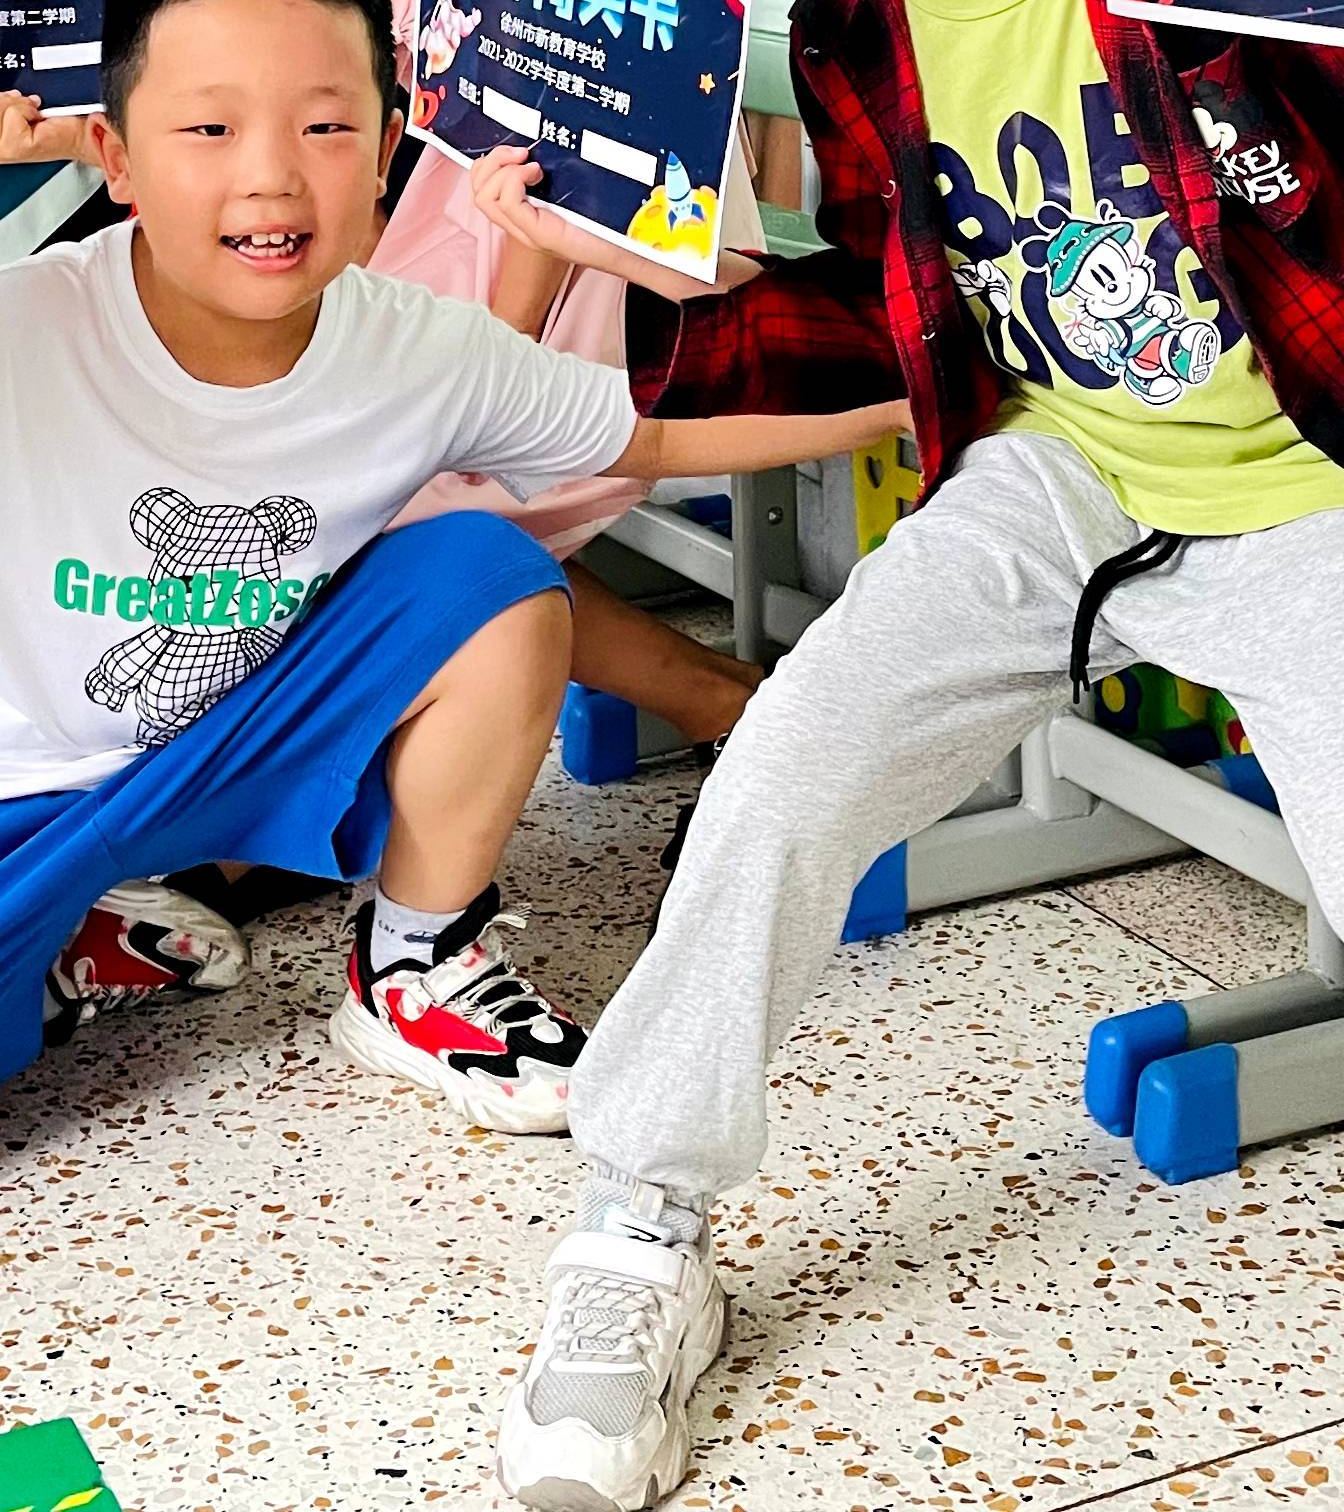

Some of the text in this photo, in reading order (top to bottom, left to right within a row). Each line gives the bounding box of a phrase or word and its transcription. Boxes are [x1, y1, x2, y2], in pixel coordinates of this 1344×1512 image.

[477, 35, 631, 116] 2021-2022学年度第二学期
[500, 11, 607, 72] 徐州市新教育学校
